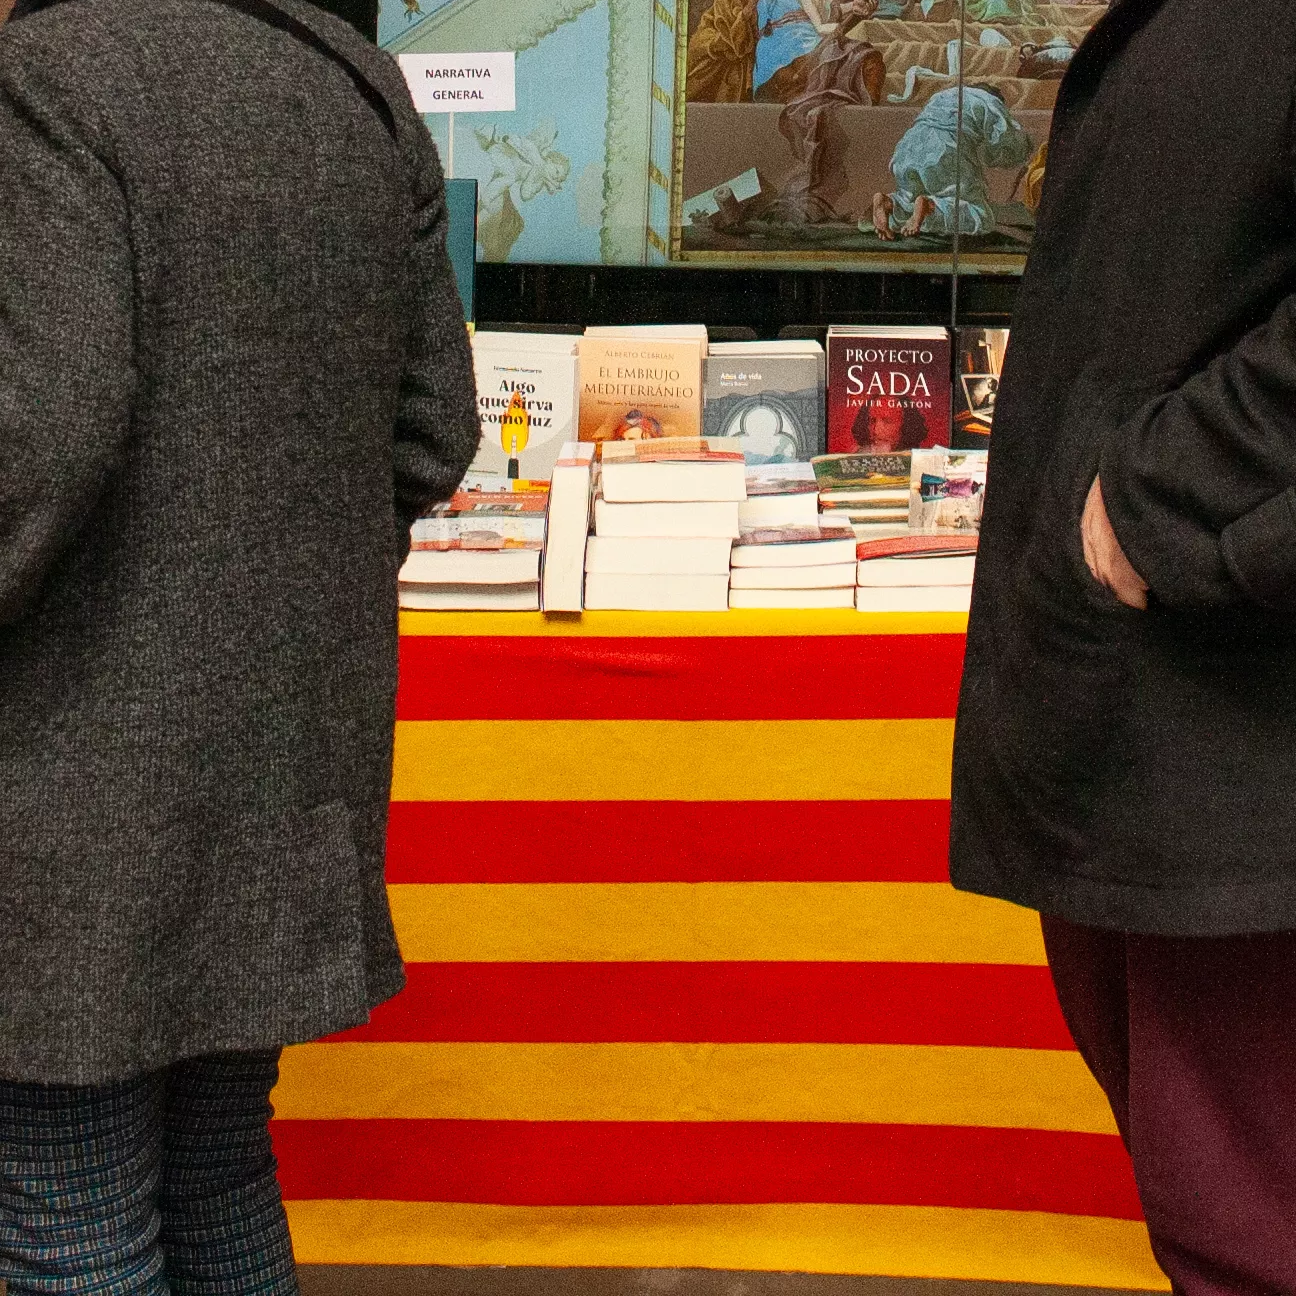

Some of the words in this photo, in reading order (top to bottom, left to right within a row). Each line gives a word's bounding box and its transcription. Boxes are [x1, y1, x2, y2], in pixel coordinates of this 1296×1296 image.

[425, 68, 492, 79] NARRATIVA
[432, 90, 485, 100] GENERAL
[604, 349, 639, 359] ALBERTO
[845, 348, 934, 365] PROYECTO
[598, 366, 612, 378] EL
[616, 367, 680, 383] EMBRUJO
[846, 364, 932, 397] SADA
[499, 379, 536, 396] Algo
[584, 382, 694, 398] MEDITERRÁNEO
[479, 396, 510, 411] que
[513, 395, 553, 411] sirva
[846, 398, 883, 409] JAVIER
[481, 413, 524, 426] como
[527, 413, 553, 428] luz
